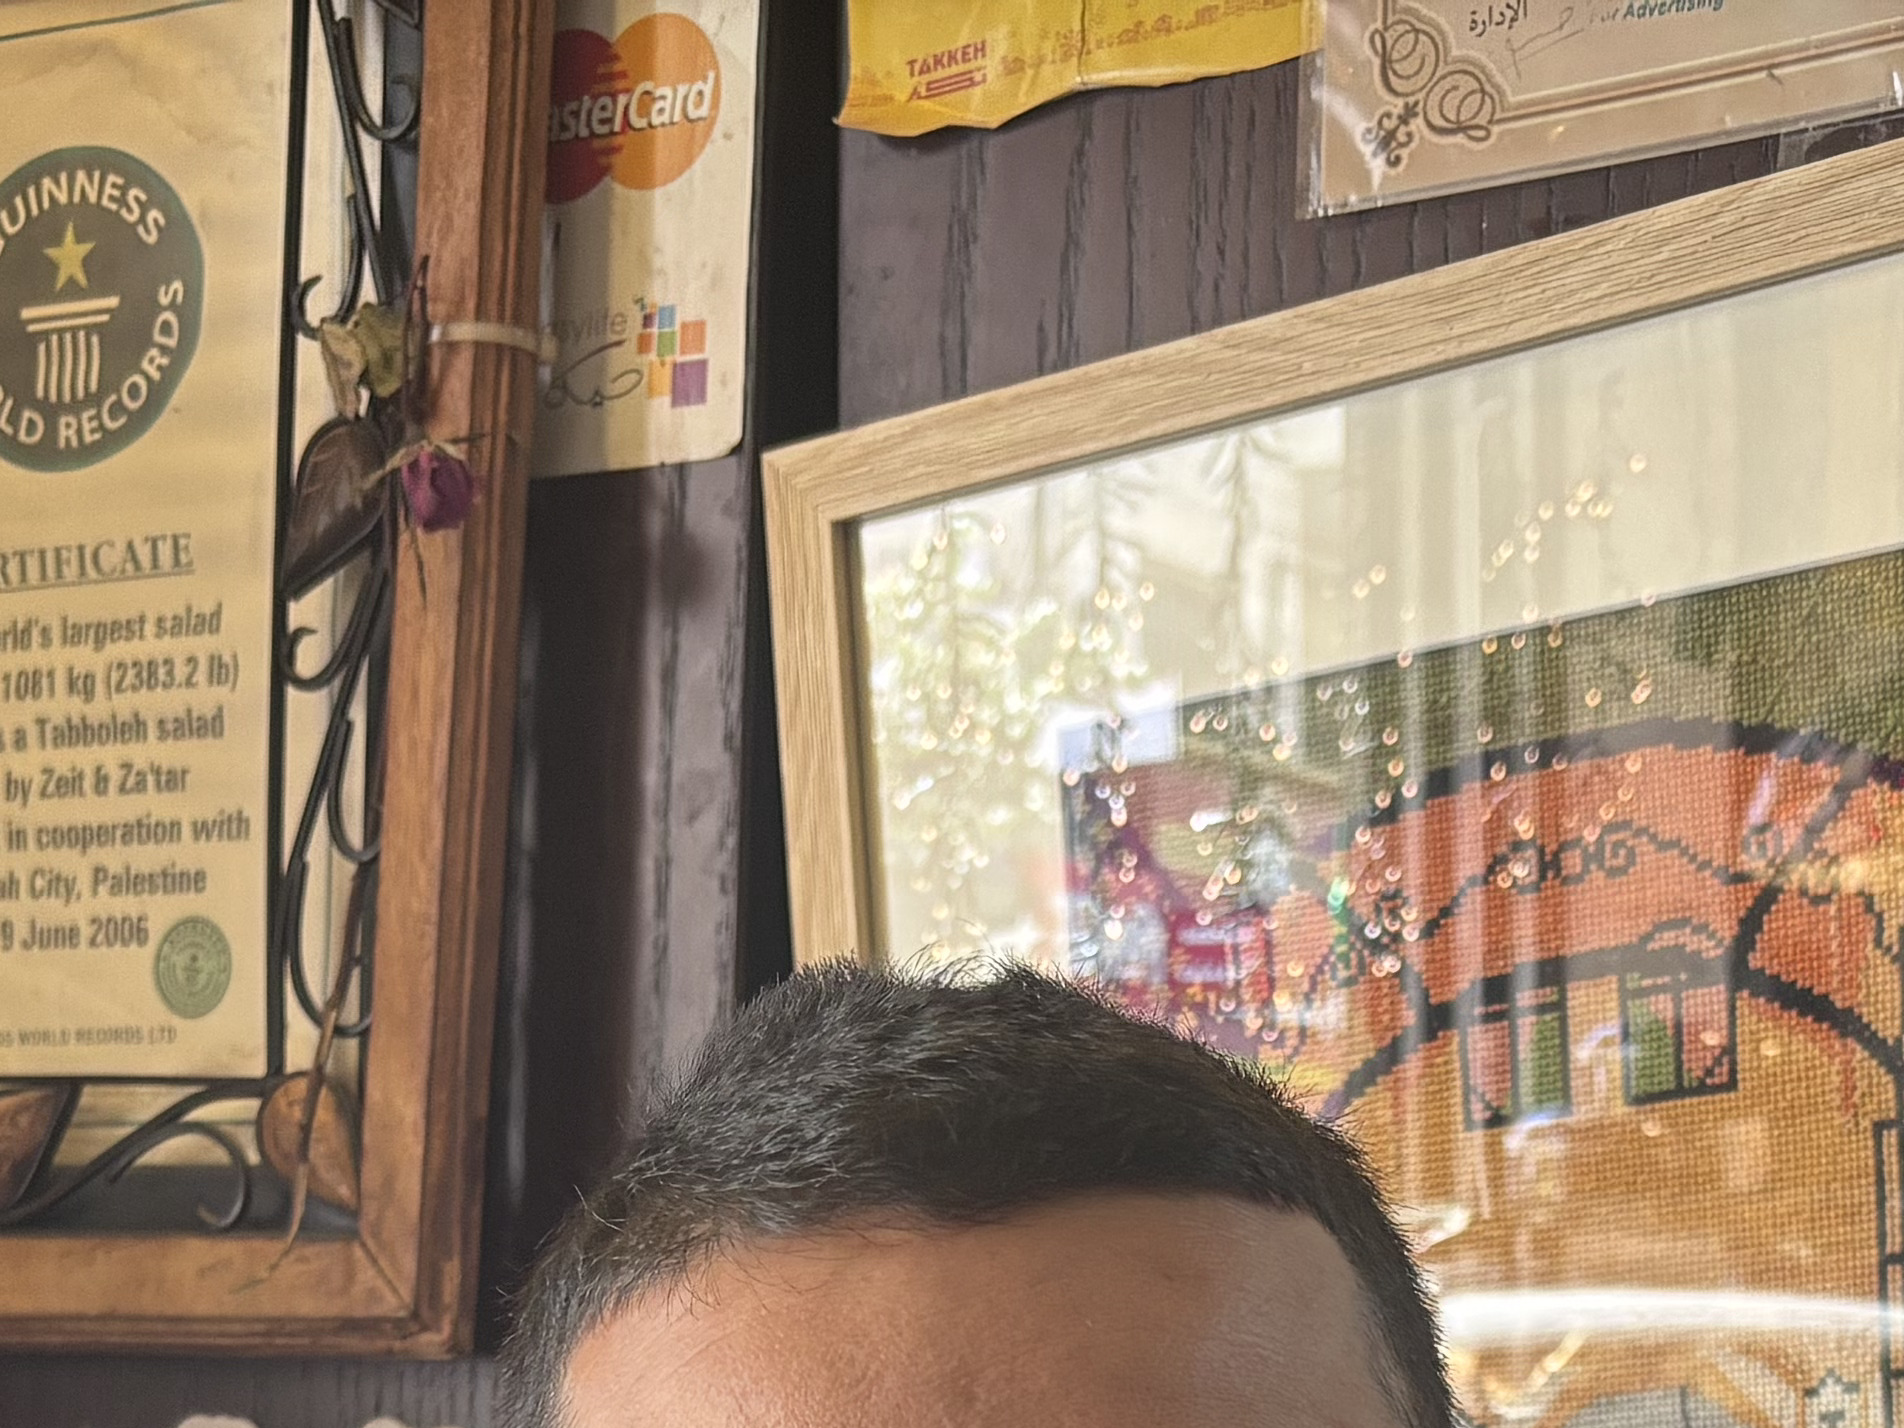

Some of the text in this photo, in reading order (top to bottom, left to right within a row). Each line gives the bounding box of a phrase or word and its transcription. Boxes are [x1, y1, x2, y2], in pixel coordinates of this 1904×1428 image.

[906, 39, 987, 78] TAKKEH
[58, 279, 184, 450] RECORDS
[60, 611, 147, 653] largest
[154, 601, 223, 639] salad
[66, 665, 96, 702] kg
[105, 655, 198, 700] (2383.2
[207, 651, 240, 693] lb)
[13, 728, 28, 751] a
[34, 710, 148, 750] Tabboleh
[156, 704, 226, 742] salad
[5, 769, 34, 809] by
[38, 765, 86, 801] Zeit
[118, 762, 191, 795] Za'tar
[7, 820, 28, 853] in
[35, 812, 182, 856] cooperation
[190, 808, 250, 843] with
[28, 866, 83, 908] City,
[91, 861, 208, 899] Palestine
[1, 918, 14, 951] 9
[21, 917, 81, 952] June
[88, 913, 149, 949] 2006
[18, 1026, 72, 1047] WORLD
[75, 1025, 145, 1046] RECORDS
[147, 1024, 178, 1045] LTD
